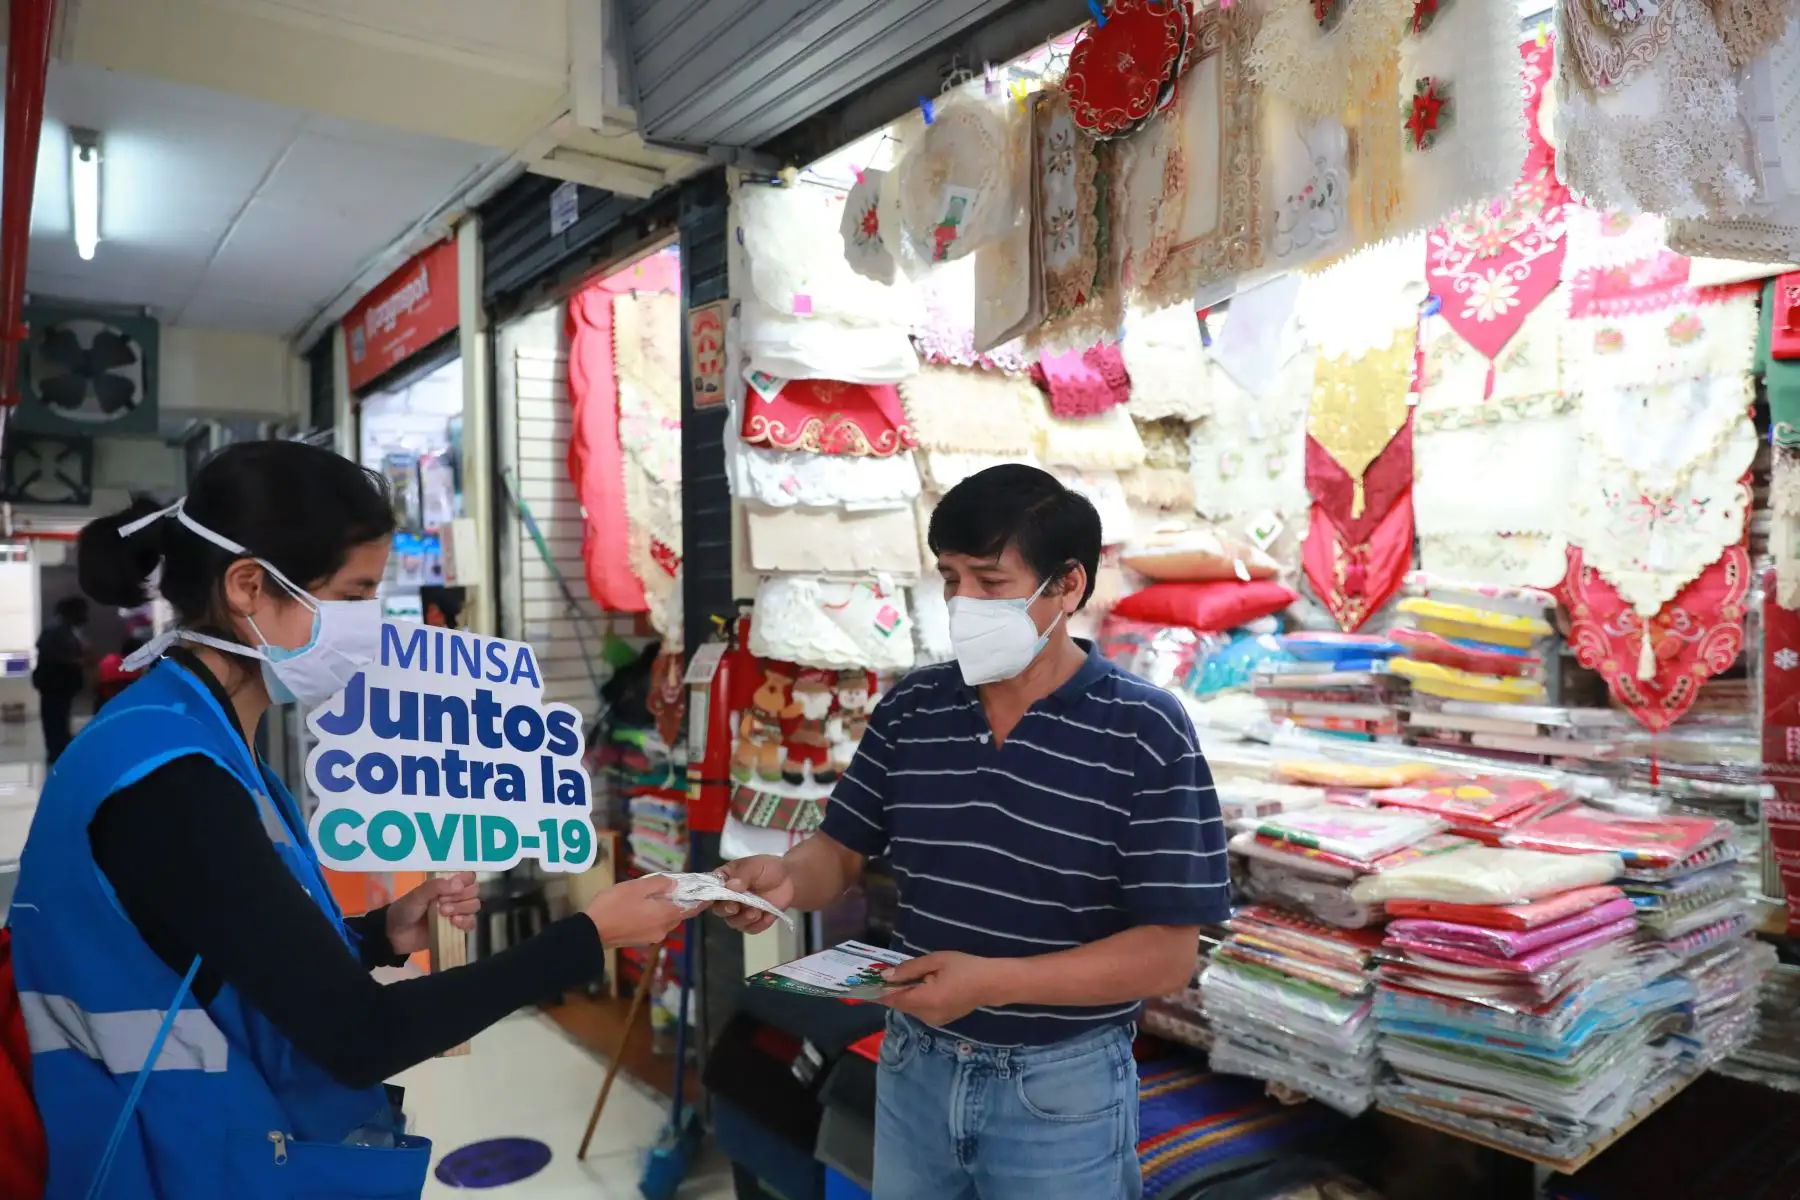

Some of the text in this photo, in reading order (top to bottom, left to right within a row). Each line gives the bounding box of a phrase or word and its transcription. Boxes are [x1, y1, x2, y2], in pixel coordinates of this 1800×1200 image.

[380, 623, 540, 689] MINSA
[316, 671, 579, 757] Juntos
[315, 748, 587, 806] contra la
[318, 808, 591, 865] COVID-19
